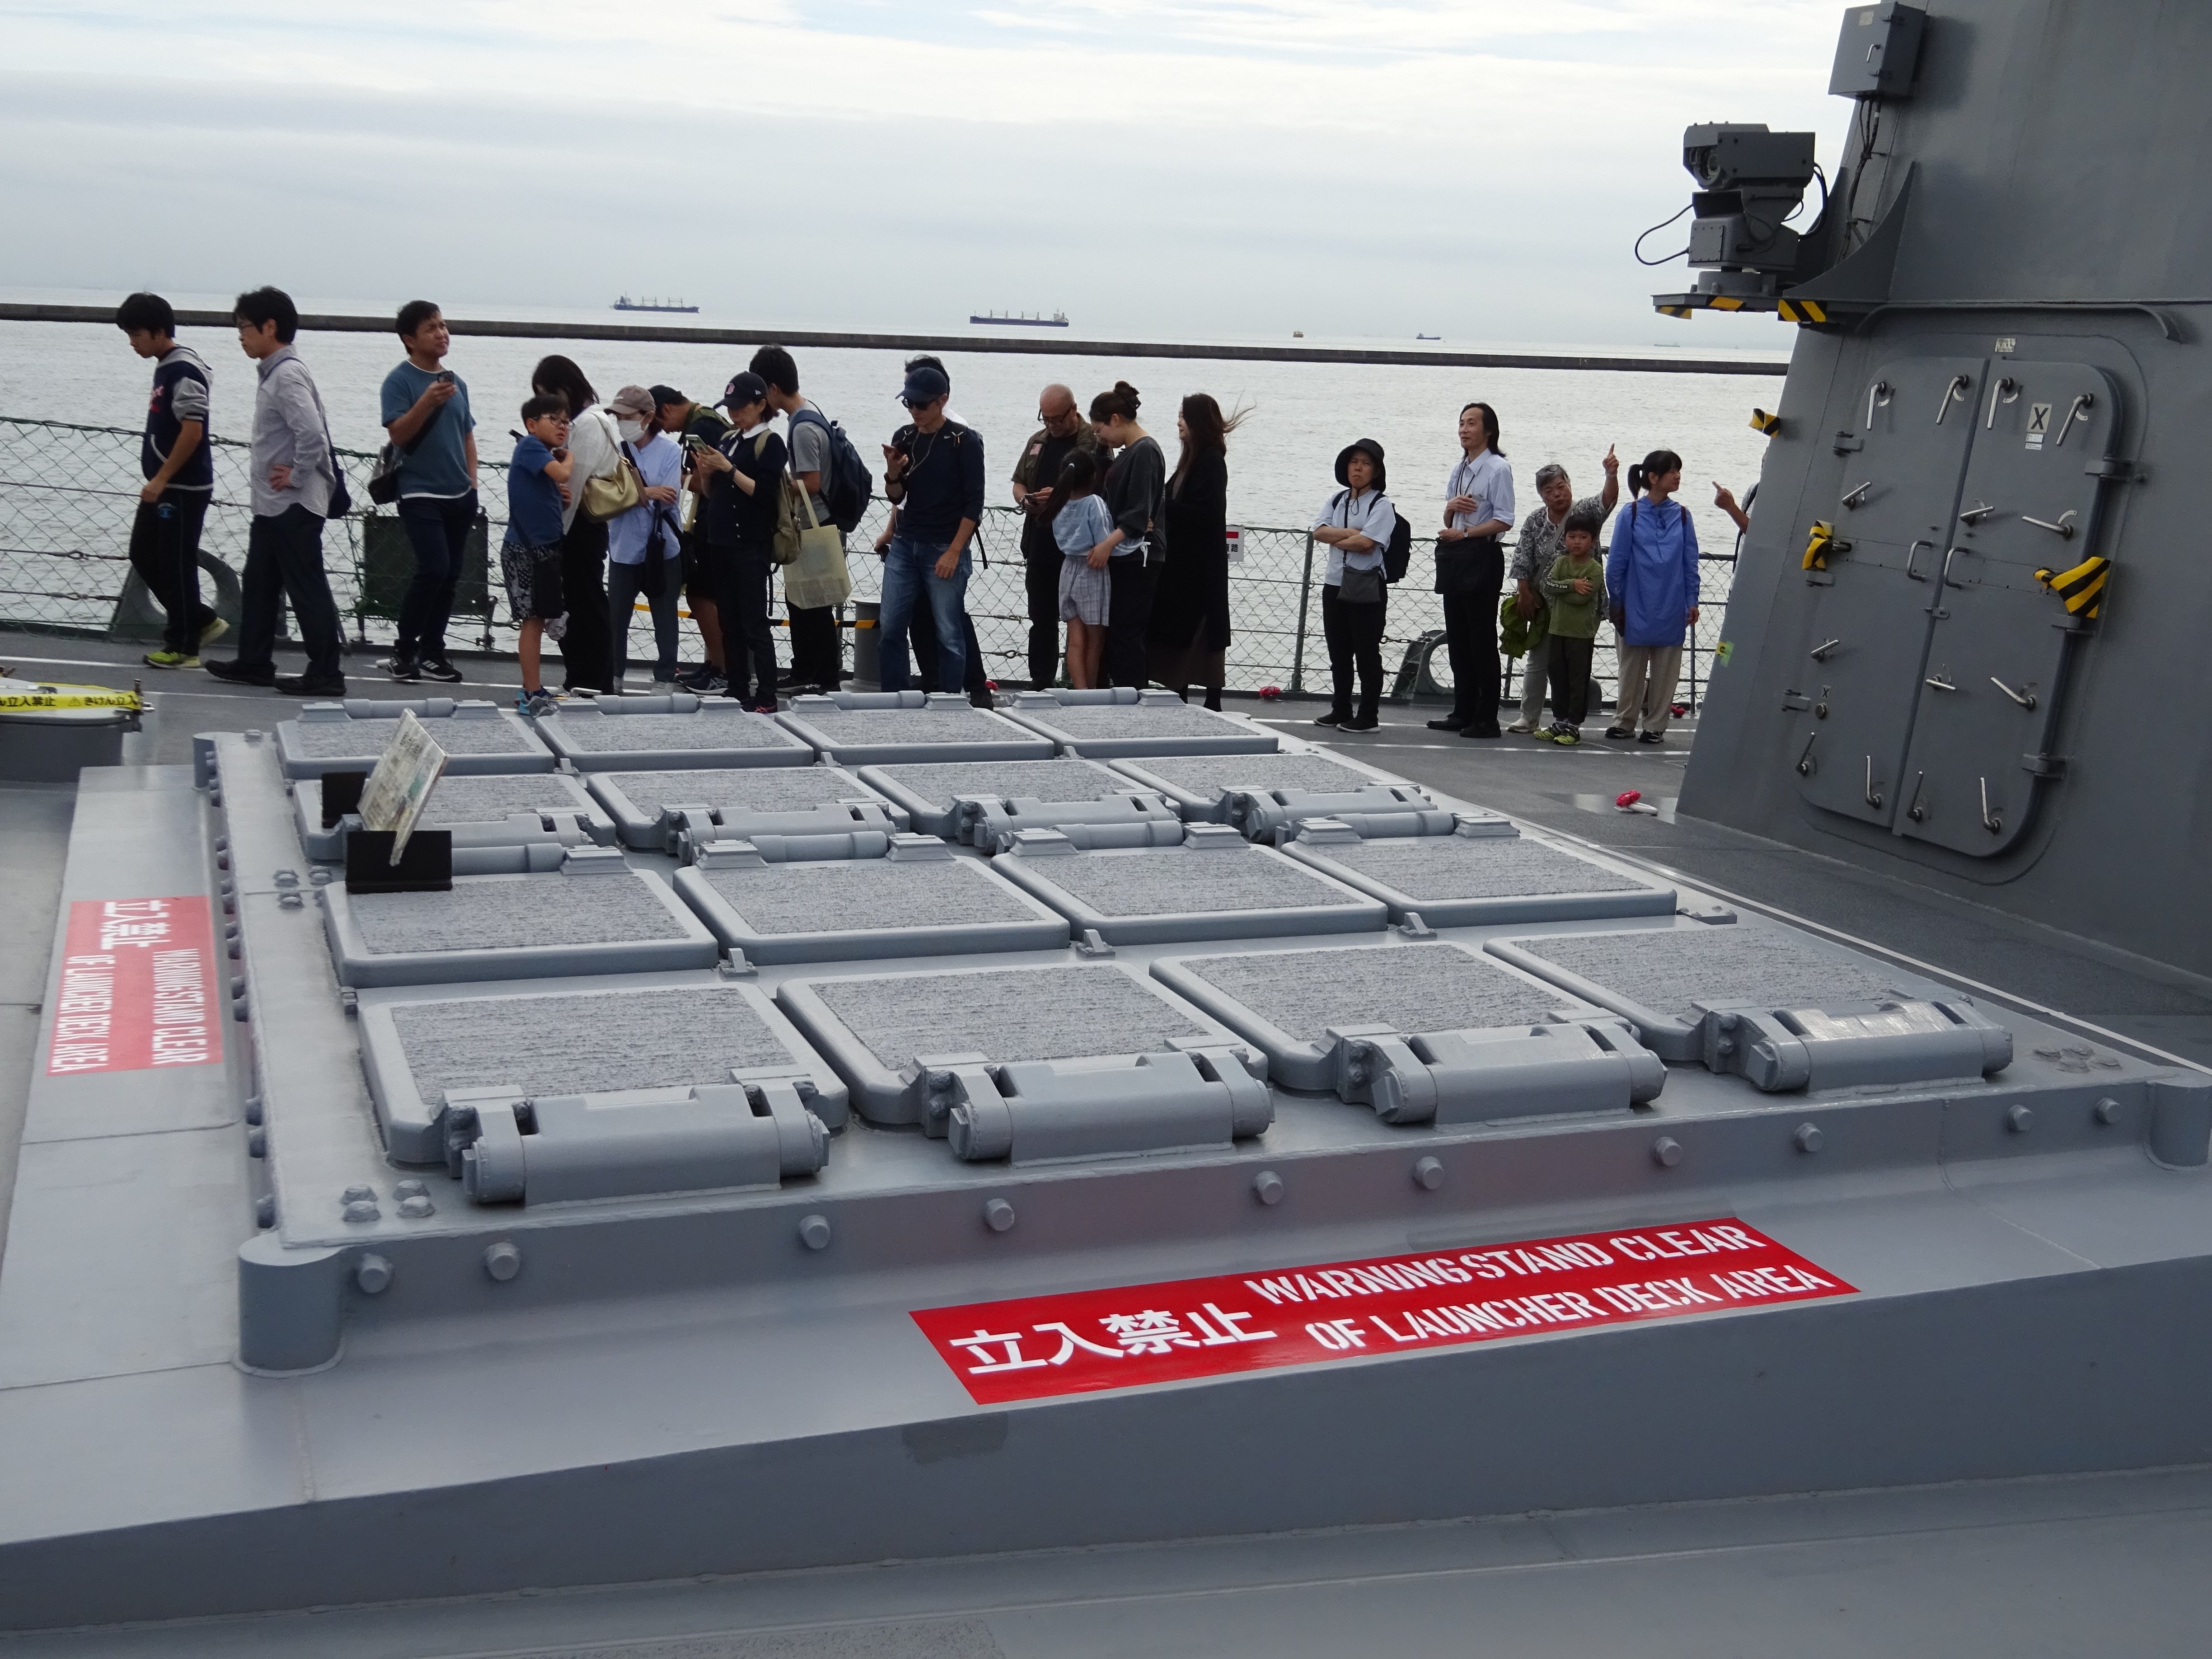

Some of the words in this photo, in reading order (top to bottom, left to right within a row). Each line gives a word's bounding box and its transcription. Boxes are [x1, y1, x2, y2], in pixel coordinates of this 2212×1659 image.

[2030, 407, 2049, 430] X
[99, 900, 172, 949] 立入禁止
[67, 955, 116, 964] OF
[60, 966, 115, 1014] LAUNCHER
[55, 1014, 111, 1041] DECK
[152, 1026, 208, 1065] CLEAR
[51, 1043, 110, 1073] AREA
[1609, 1226, 1767, 1261] CLEAR
[1305, 1318, 1366, 1350] OF
[1369, 1291, 1610, 1342] LAUNCHER
[1592, 1277, 1724, 1313] DECK
[1709, 1265, 1836, 1299] AREA
[949, 1303, 1278, 1374] 立入禁止
